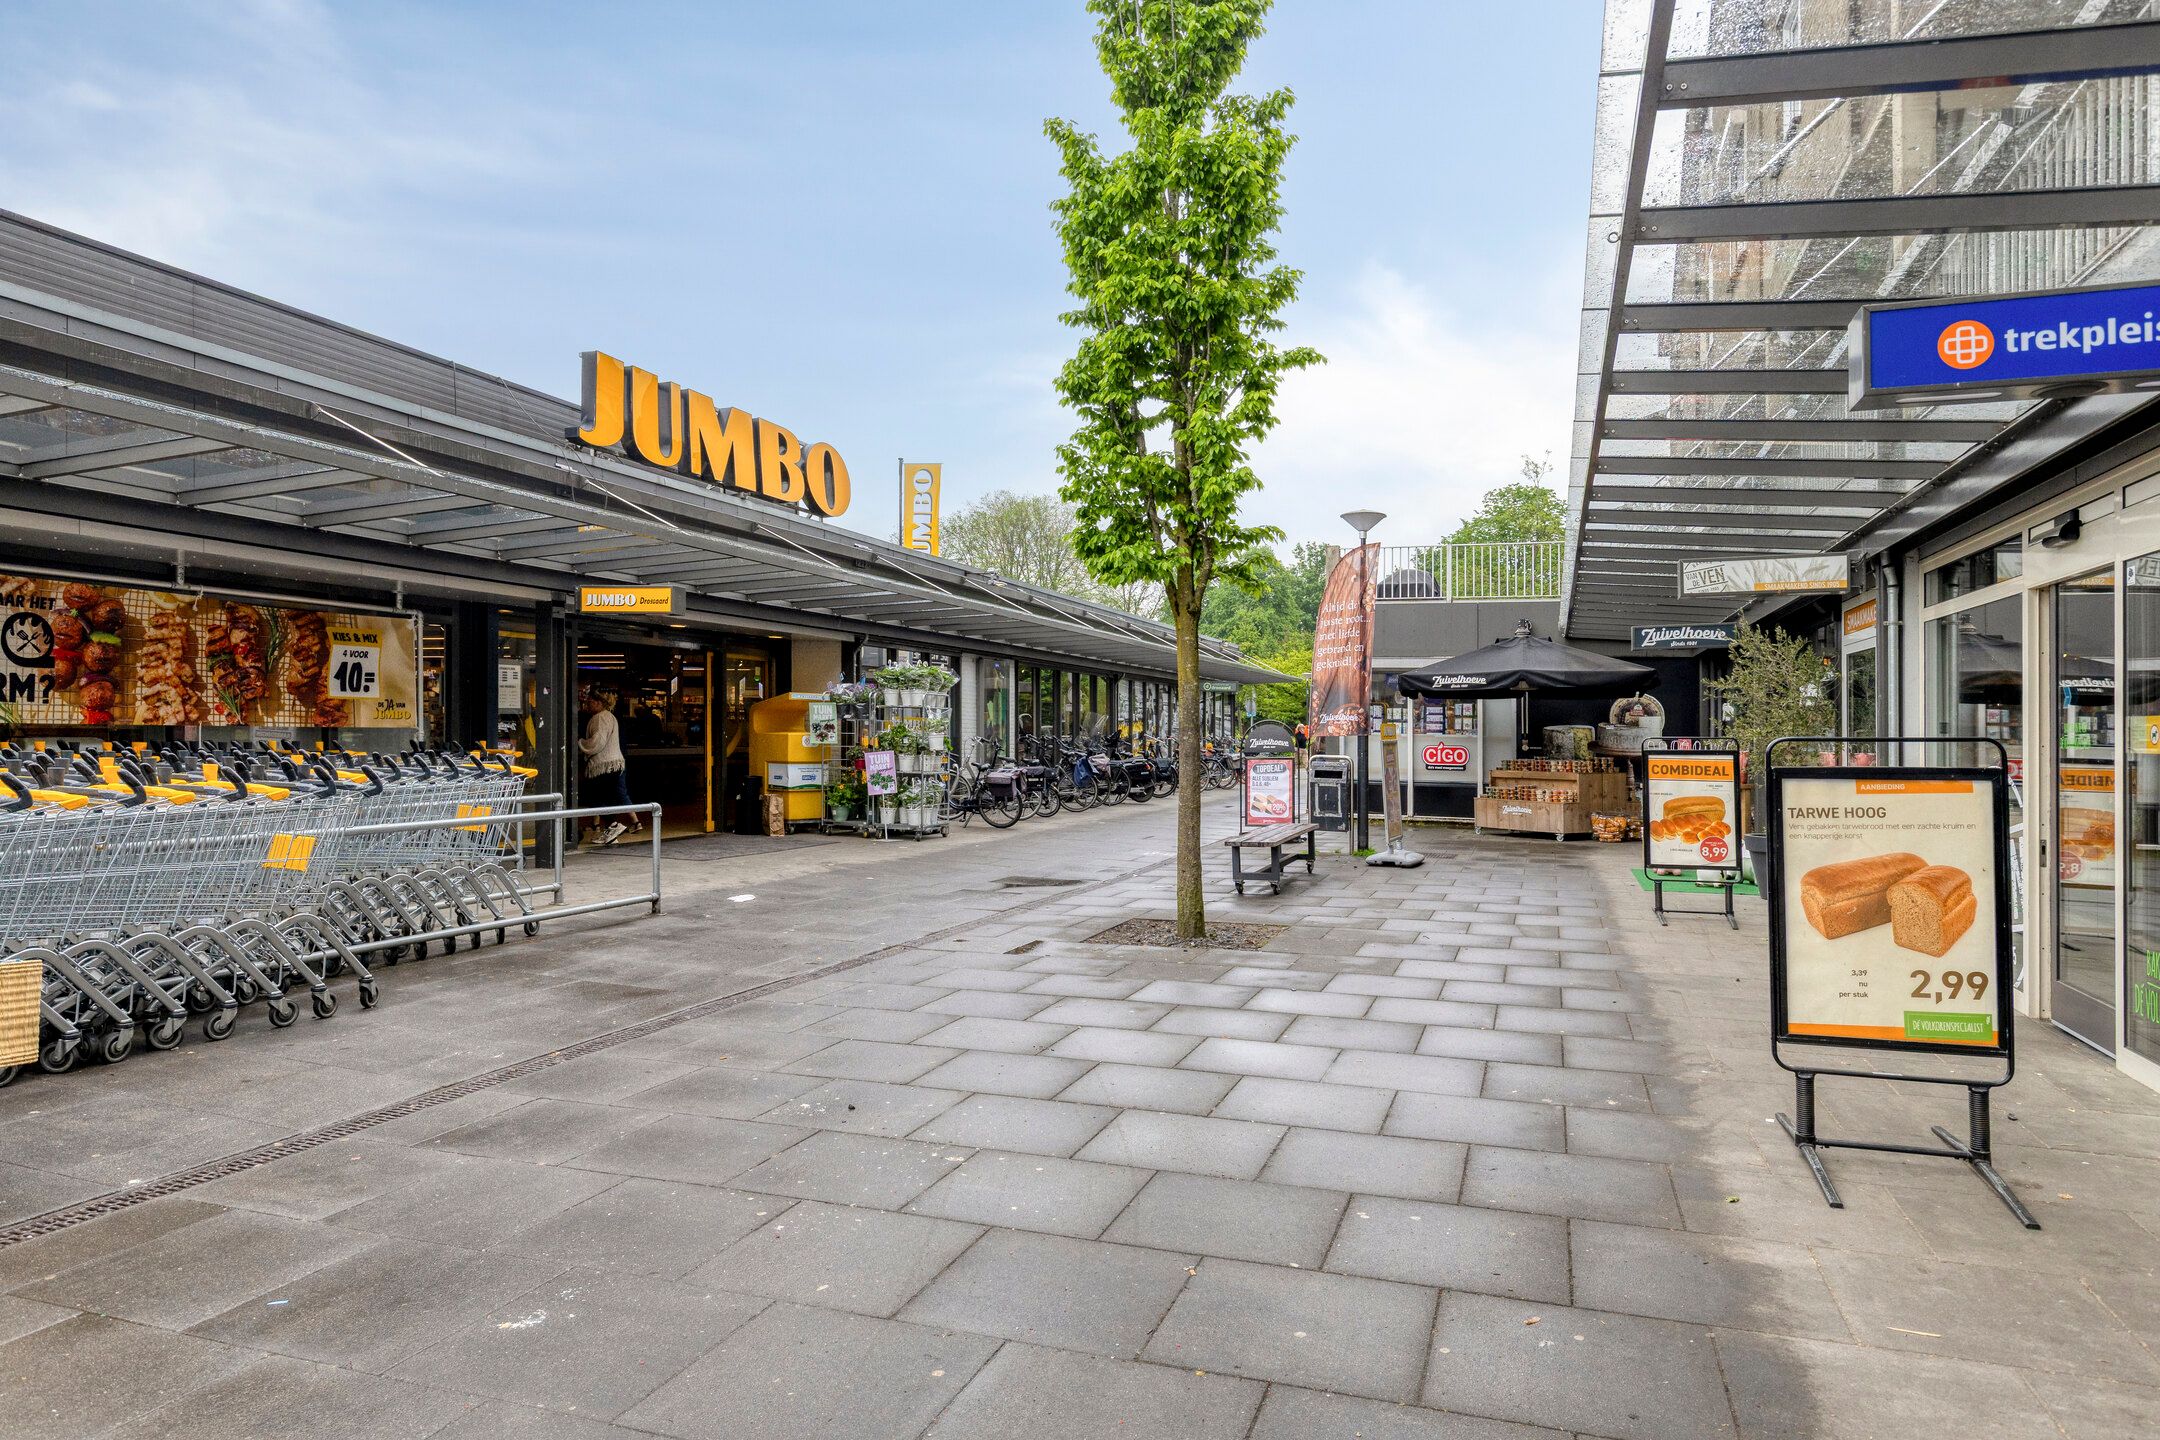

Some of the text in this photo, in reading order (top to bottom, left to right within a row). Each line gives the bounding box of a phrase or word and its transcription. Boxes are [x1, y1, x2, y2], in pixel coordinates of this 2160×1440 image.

[579, 350, 852, 518] JUMBO
[1698, 567, 1726, 585] VEN
[1764, 580, 1840, 591] SMAAKMAKEND SINDS 1905
[30, 595, 56, 610] HET
[585, 593, 637, 606] JUMBO
[332, 631, 378, 643] KIES & MIX
[1641, 626, 1727, 648] Zuivelhoeve
[342, 649, 369, 658] 4 VOOR
[1432, 675, 1487, 688] Zuivelhoeve
[384, 699, 395, 711] JA
[812, 704, 833, 714] TUIN
[373, 709, 412, 720] JUMBO
[1249, 738, 1290, 749] Zuivelhoeve
[868, 753, 890, 764] TUIN
[1256, 763, 1284, 773] TOPDEAL!
[1651, 764, 1730, 777] COMBIDEAL
[1860, 783, 1905, 791] AANBIEDING
[1787, 806, 1887, 819] TARWE HOOG
[1788, 823, 1805, 831] Vers
[1806, 822, 1840, 833] gebakken
[1842, 822, 1884, 831] tarwebrood
[1886, 823, 1900, 831] met
[1917, 822, 1941, 831] zachte
[1943, 822, 1966, 830] kruim
[1804, 832, 1844, 842] knapperige
[1845, 832, 1864, 840] korst
[1701, 845, 1728, 859] 8,99
[1851, 969, 1868, 977] 3,39
[1910, 969, 1989, 1005] 2,99
[1853, 990, 1869, 998] stuk
[1912, 1018, 1921, 1031] DÉ
[1922, 1020, 1984, 1033] VOLKORENSPECIALIST
